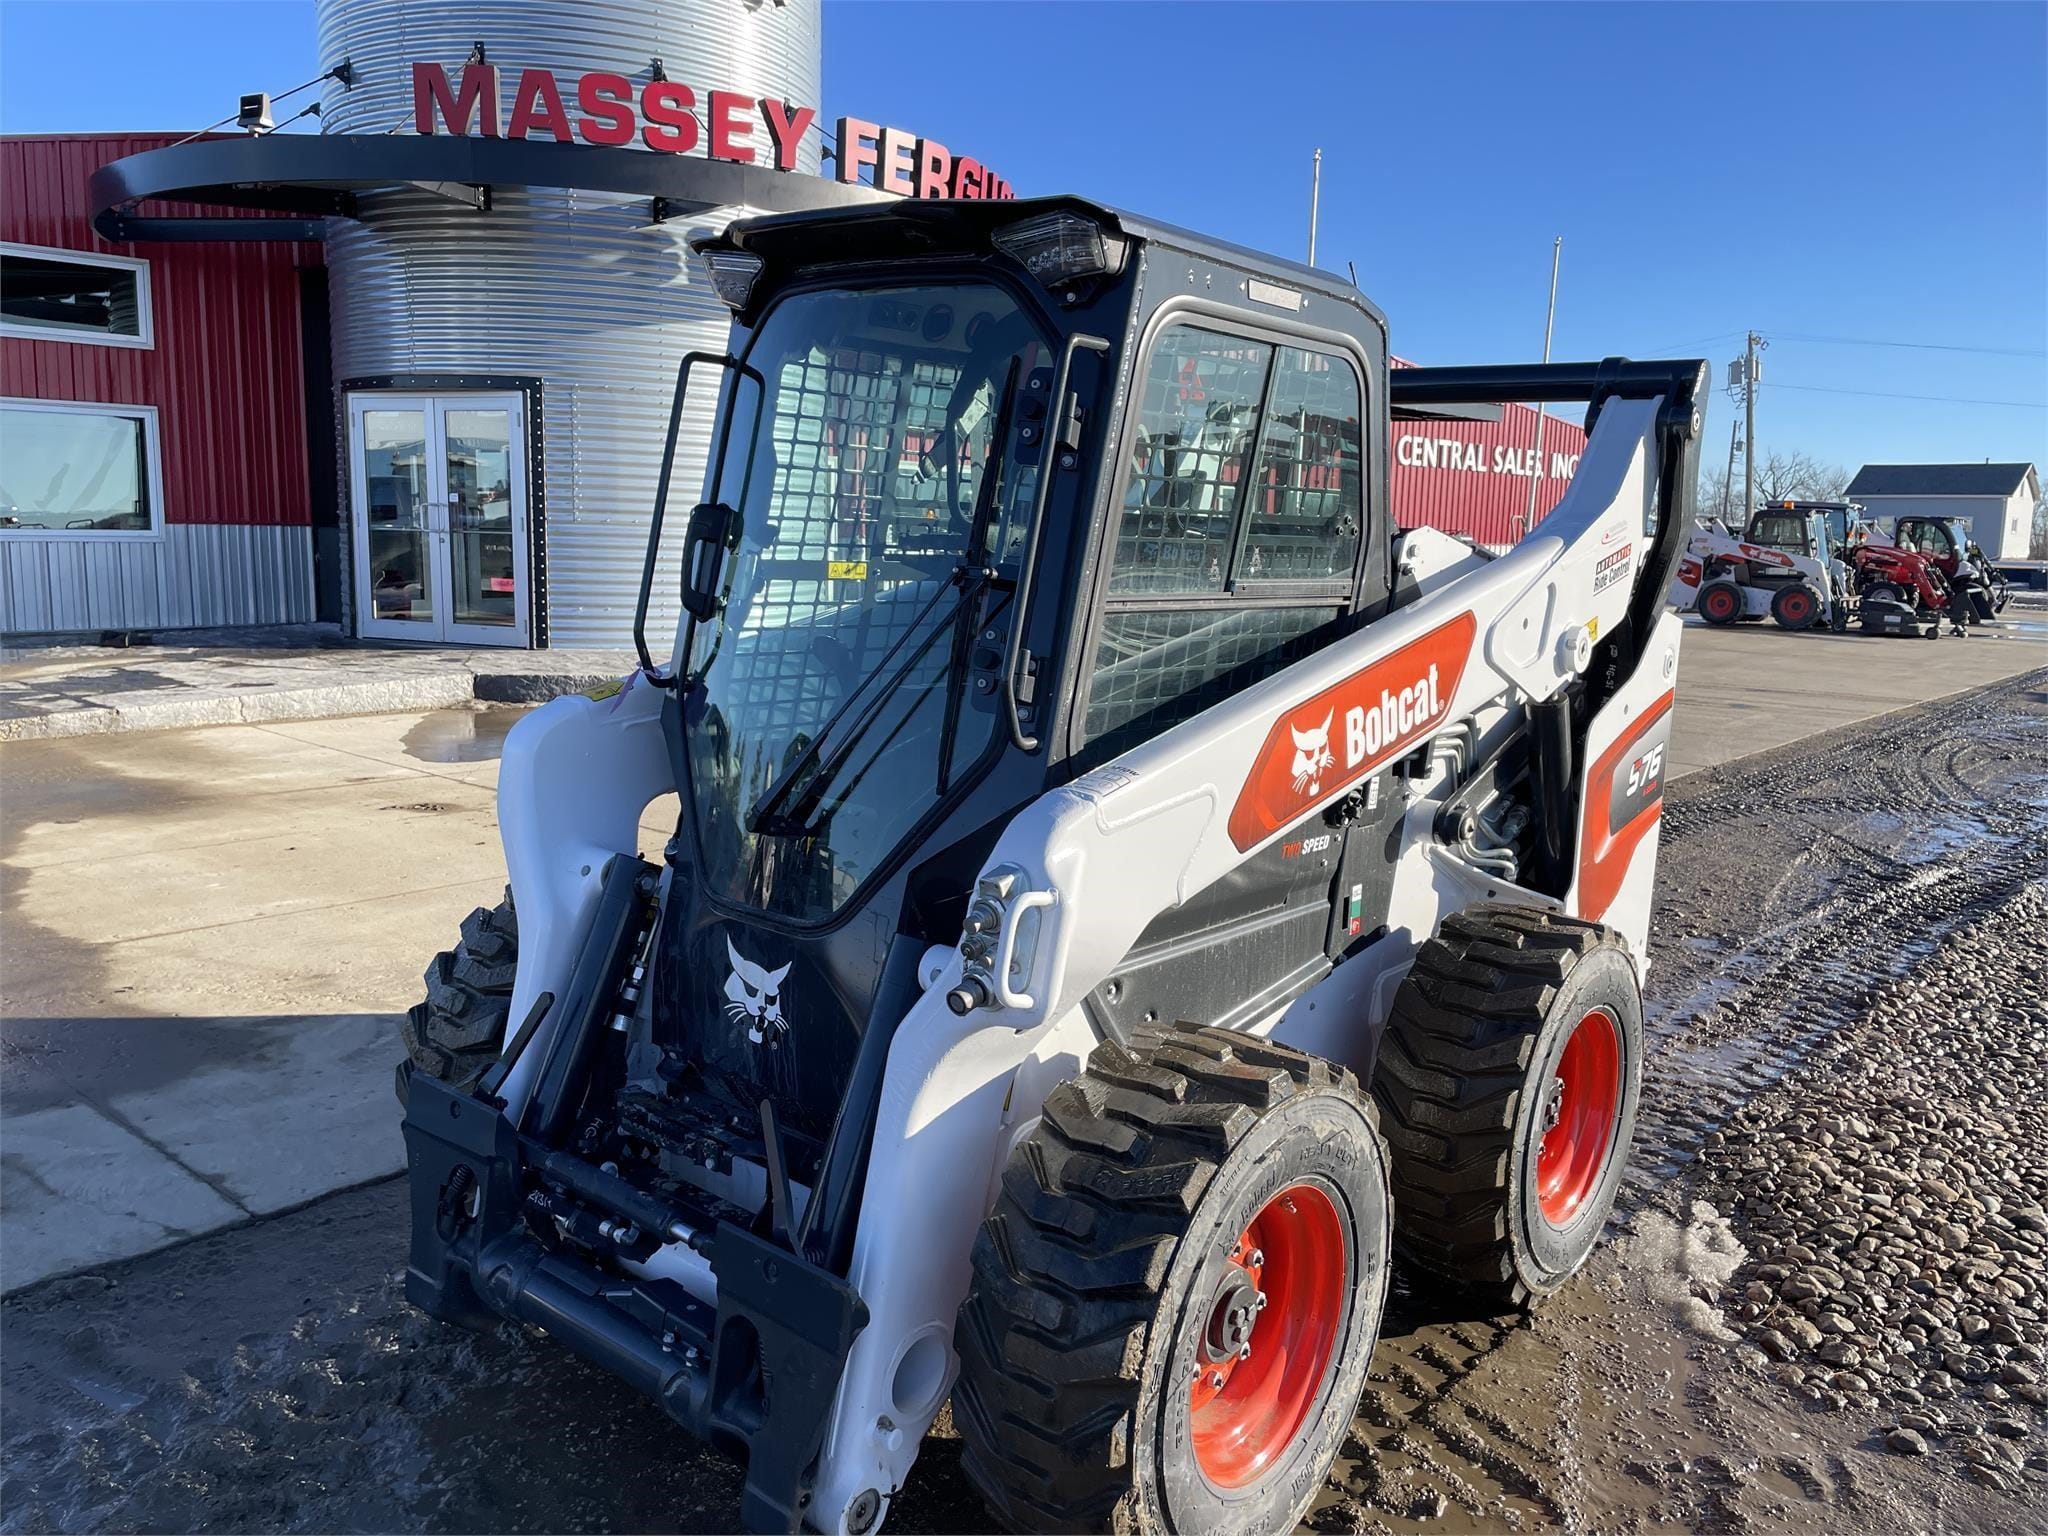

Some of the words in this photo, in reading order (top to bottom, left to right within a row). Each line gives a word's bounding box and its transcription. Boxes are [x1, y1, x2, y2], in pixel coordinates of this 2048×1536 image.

[412, 61, 816, 171] MASSEY
[1397, 435, 1487, 472] CENTRAL
[1608, 557, 1631, 583] Control
[1346, 663, 1438, 769] Bobcat
[1626, 741, 1664, 797] S76
[1281, 841, 1301, 860] TWO
[1302, 834, 1330, 856] SPEED
